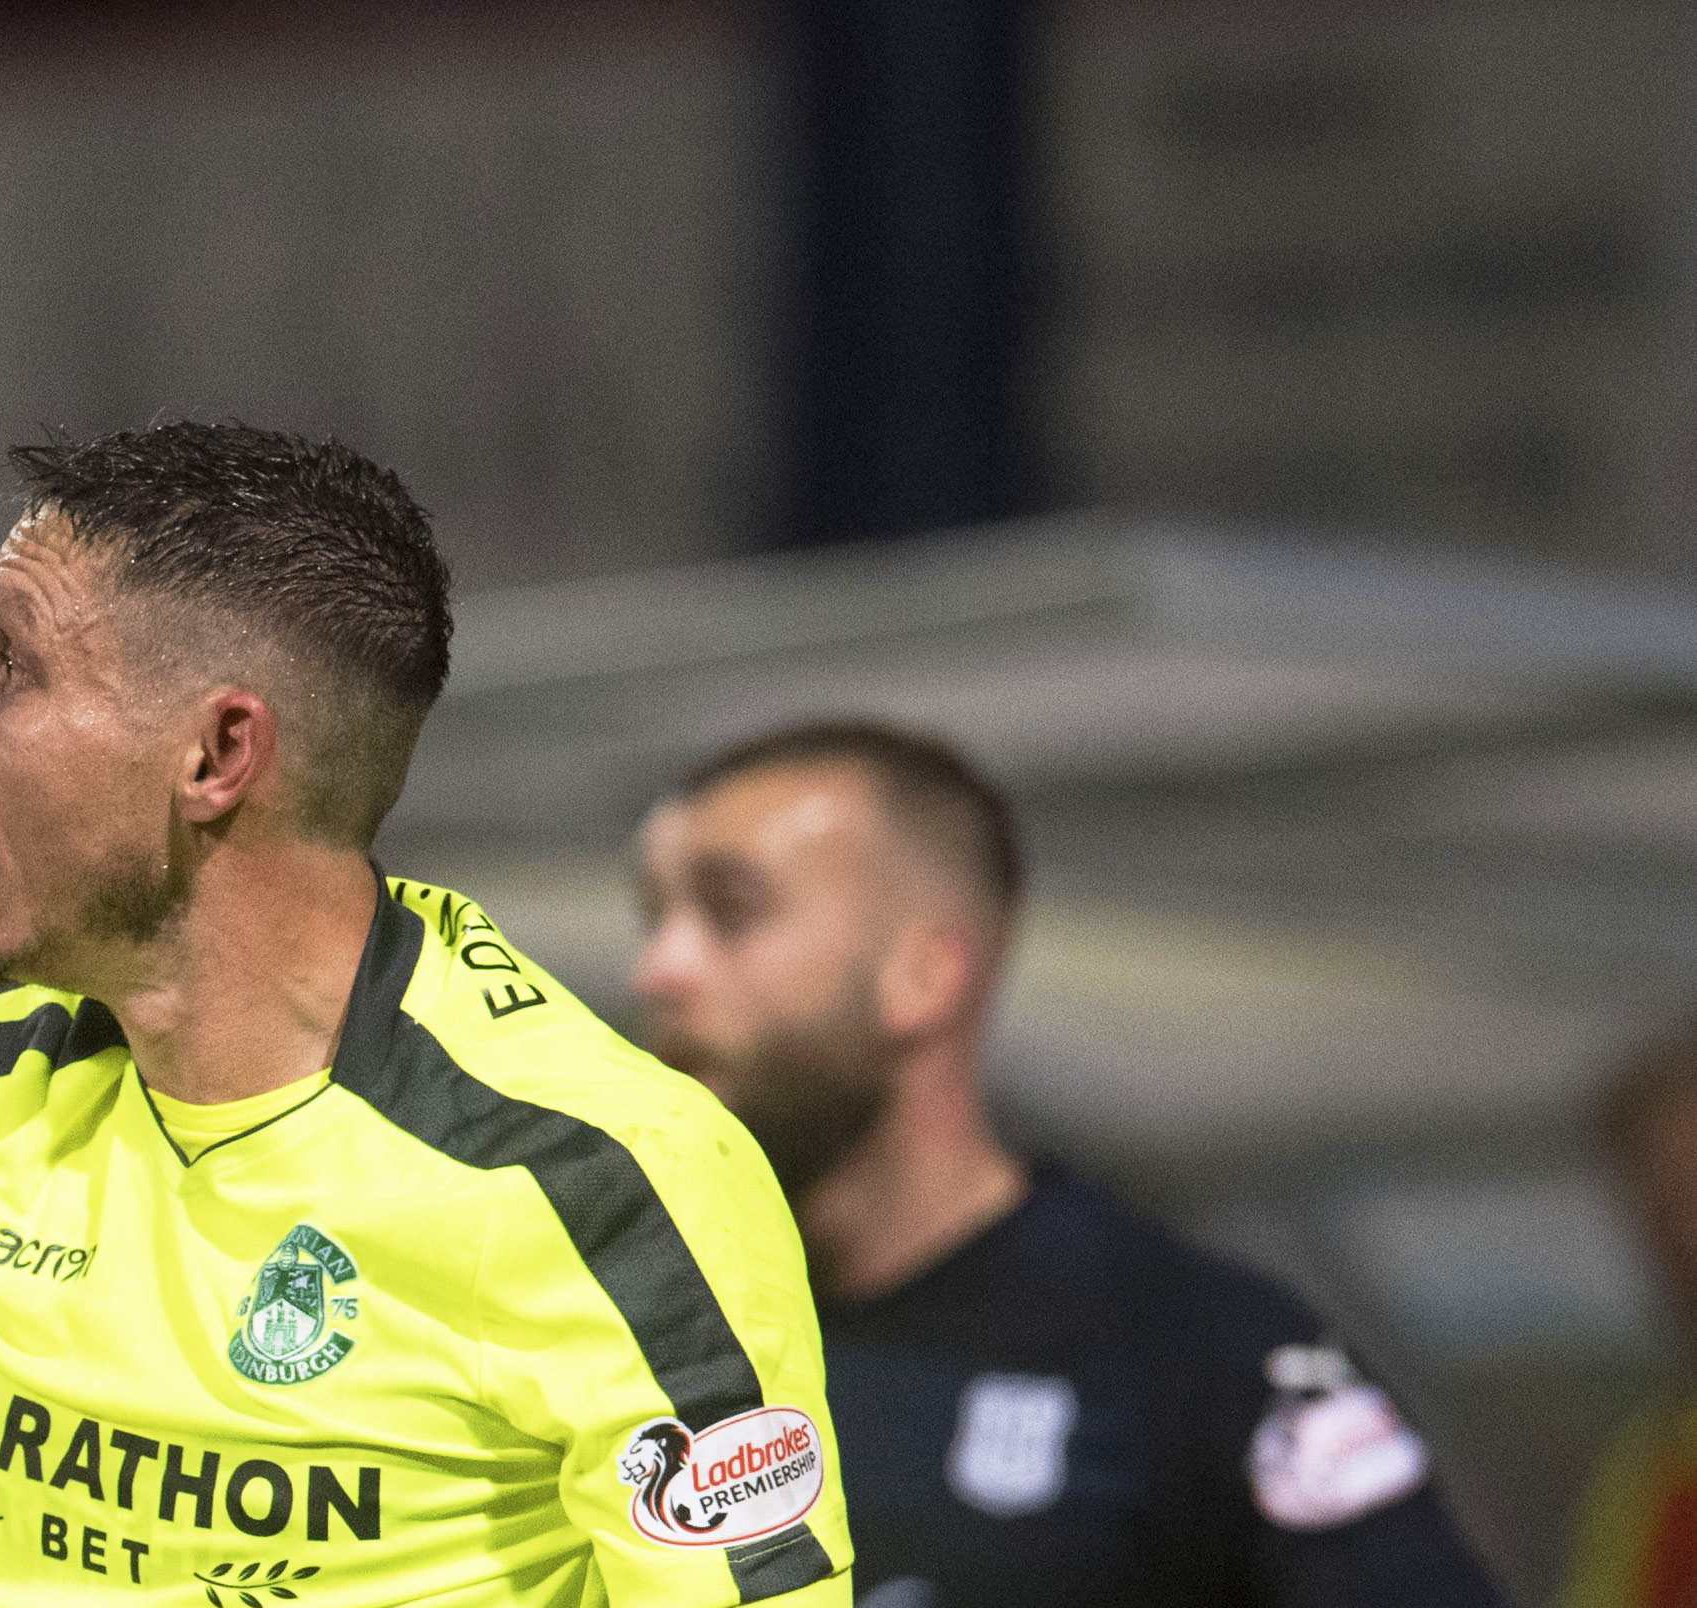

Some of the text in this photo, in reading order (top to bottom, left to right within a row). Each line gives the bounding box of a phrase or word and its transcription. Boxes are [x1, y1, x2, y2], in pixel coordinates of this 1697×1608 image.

[691, 1423, 811, 1492] Ladbrokes
[699, 1450, 817, 1514] PREMIERSHIP
[41, 1512, 150, 1585] BET
